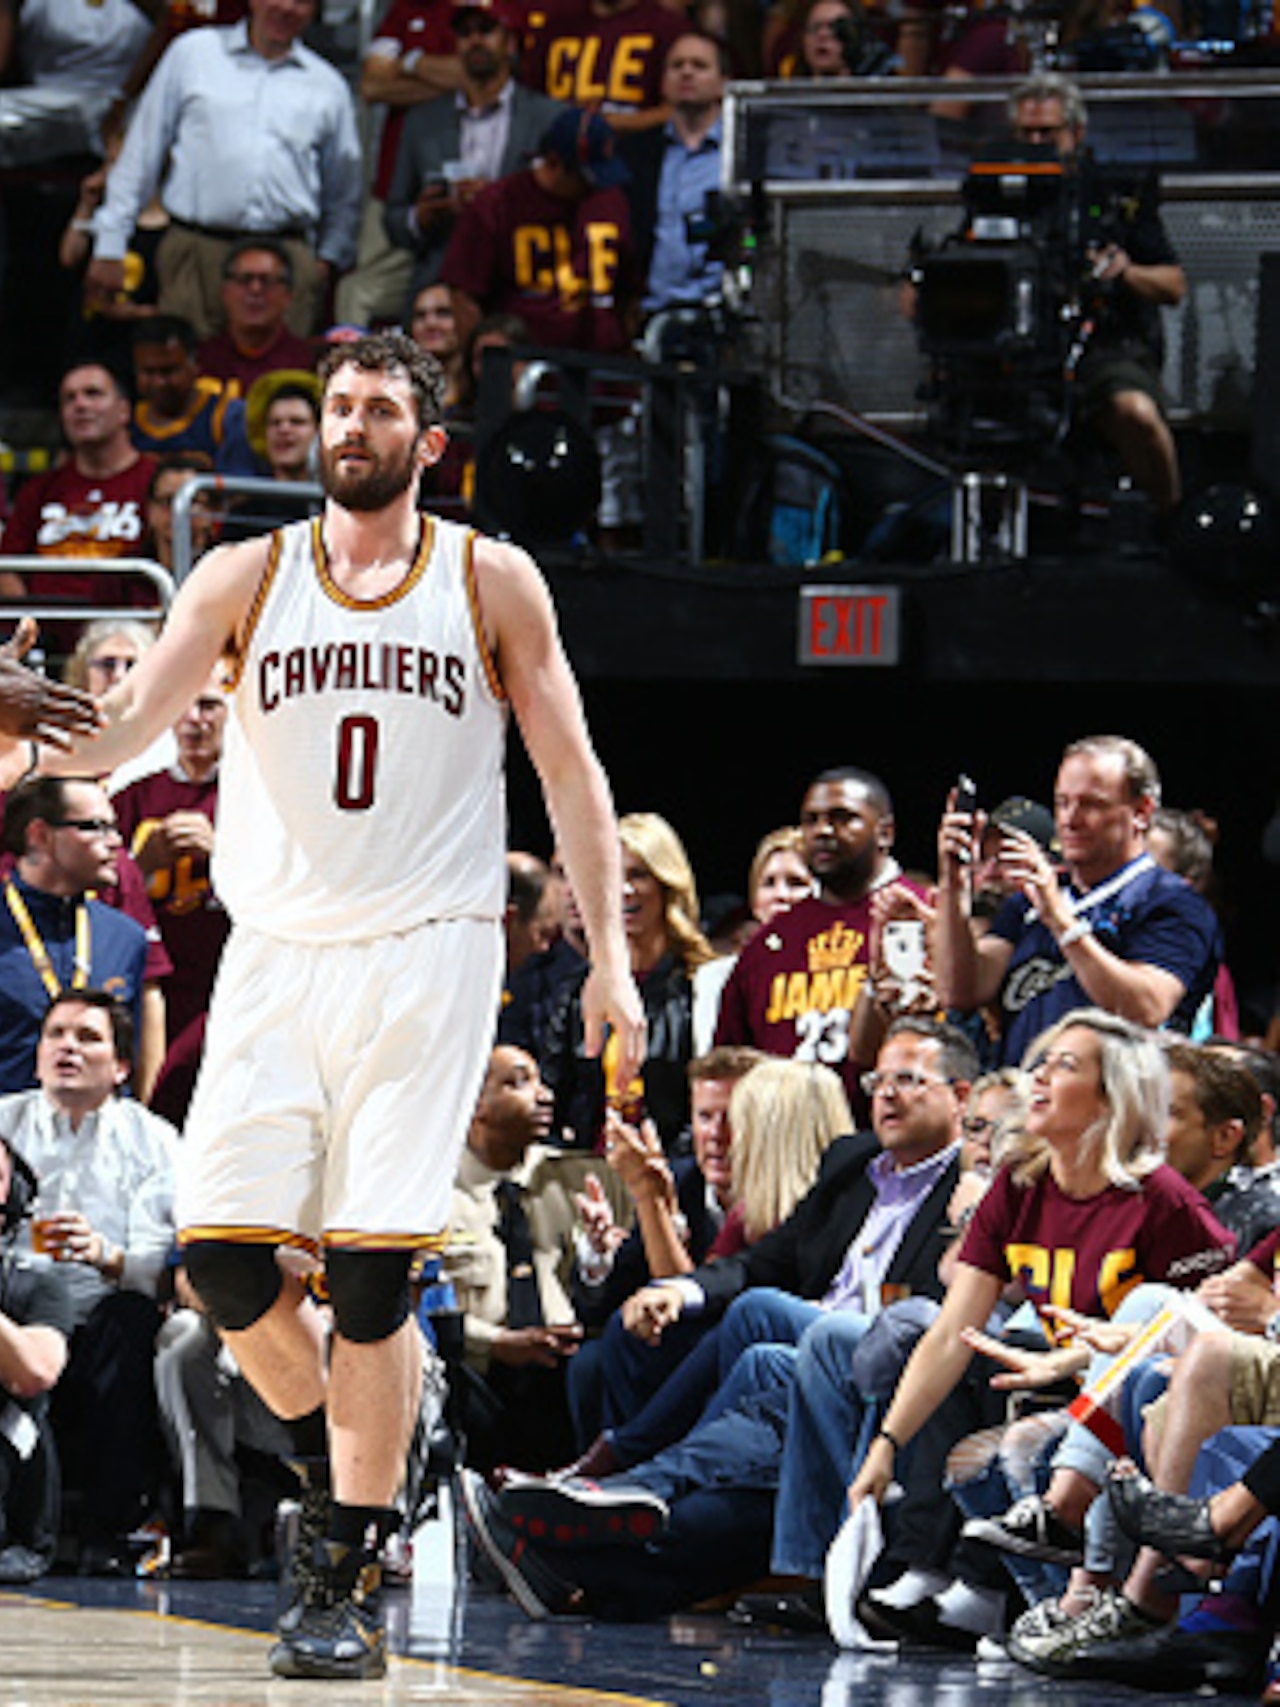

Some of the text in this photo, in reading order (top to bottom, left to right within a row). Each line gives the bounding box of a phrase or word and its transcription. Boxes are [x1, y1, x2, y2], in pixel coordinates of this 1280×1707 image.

[545, 34, 654, 103] CLE
[810, 596, 889, 656] EXIT
[259, 643, 465, 717] CAVALIERS
[334, 714, 379, 810] 0
[794, 1008, 851, 1063] 23
